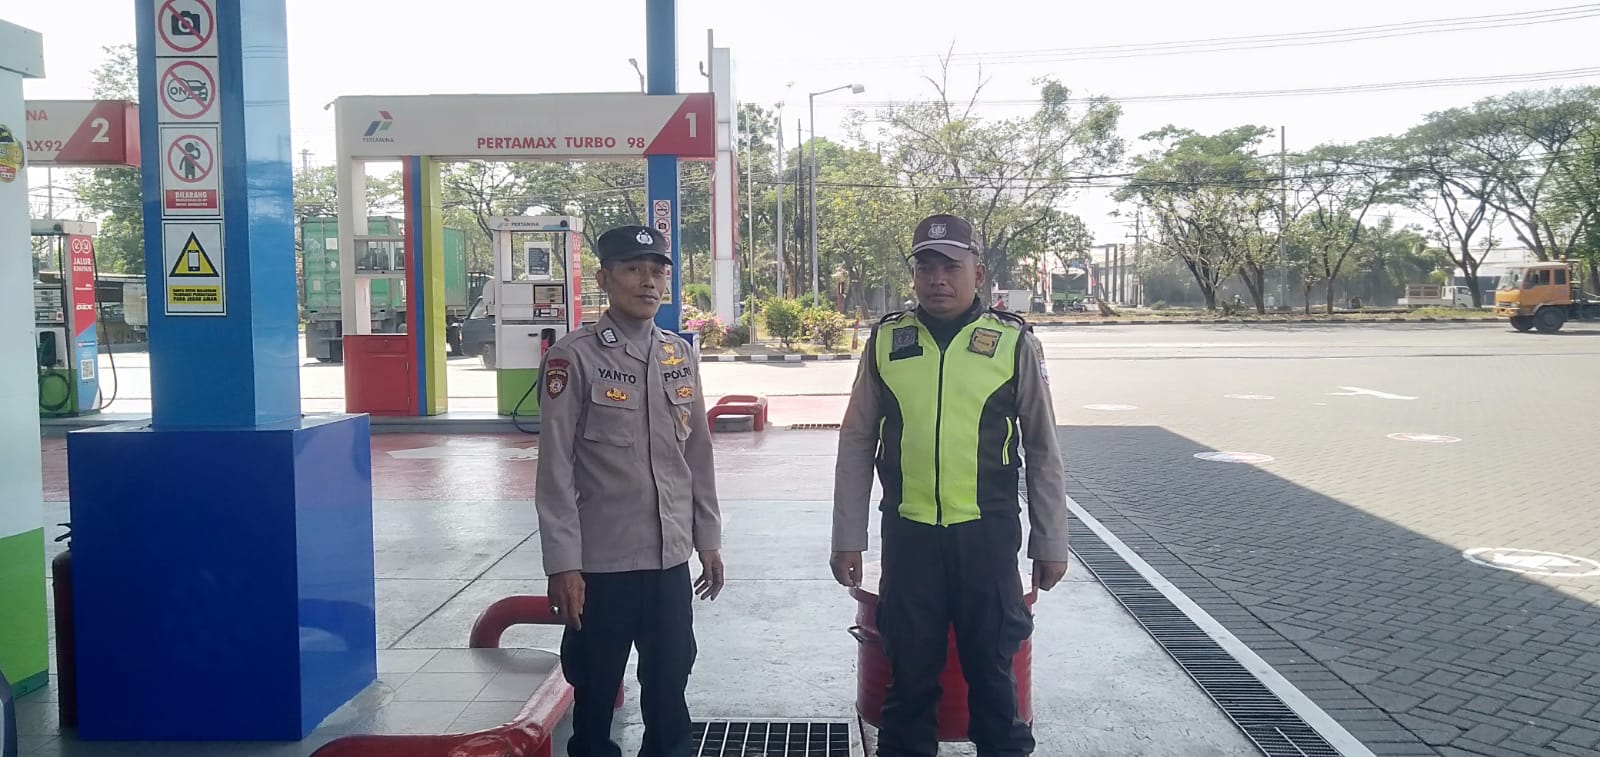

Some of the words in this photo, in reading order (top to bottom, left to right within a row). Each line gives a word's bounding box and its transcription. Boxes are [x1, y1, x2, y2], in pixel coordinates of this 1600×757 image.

[170, 86, 187, 96] ON
[91, 117, 110, 143] 2
[685, 112, 697, 138] 1
[477, 137, 556, 149] PERTAMAX
[564, 137, 616, 149] TURBO
[627, 137, 645, 149] 98
[175, 191, 208, 199] DILARANG
[73, 257, 91, 265] JALUR
[598, 368, 637, 385] YANTO
[663, 366, 692, 382] POLRI
